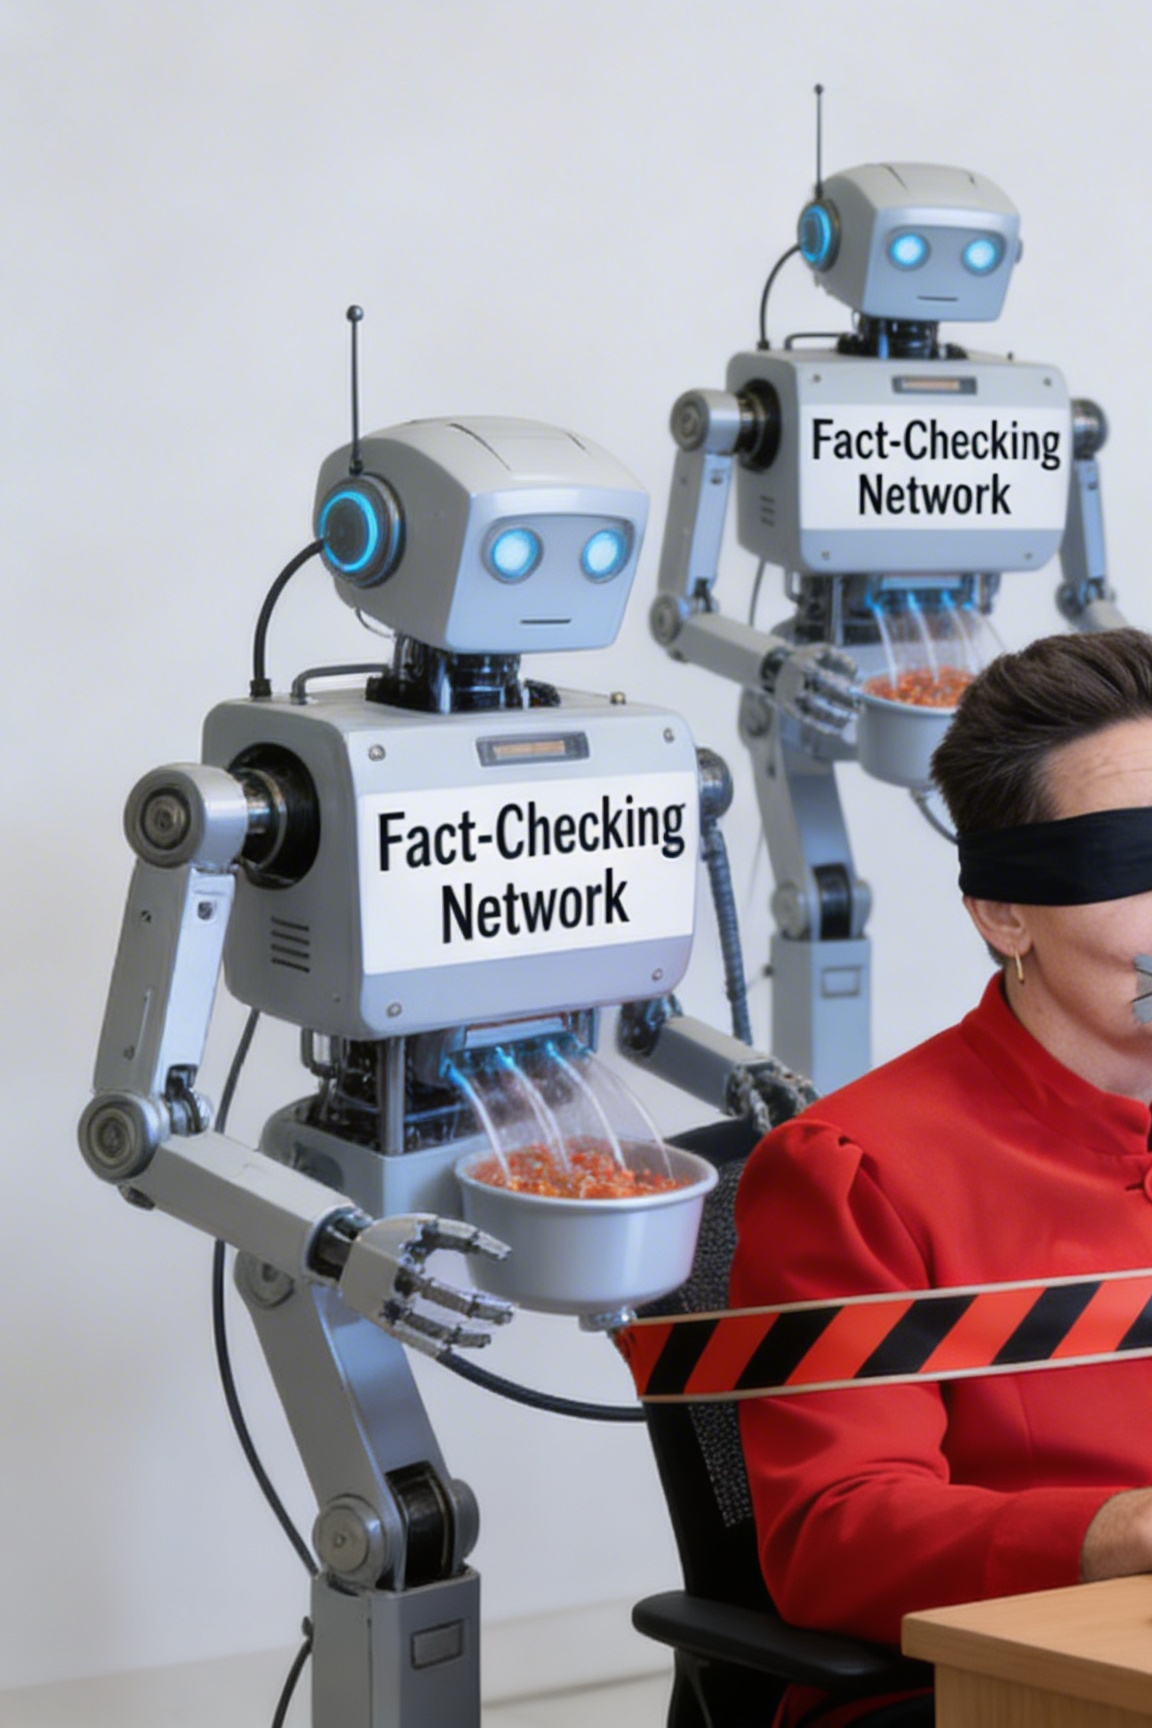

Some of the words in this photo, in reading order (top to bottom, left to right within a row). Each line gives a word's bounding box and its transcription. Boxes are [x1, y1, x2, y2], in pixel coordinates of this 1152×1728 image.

[813, 418, 1061, 471] Fact-Checking
[859, 473, 1011, 515] Network
[379, 795, 685, 872] Fact-Checking
[442, 867, 630, 944] Network
